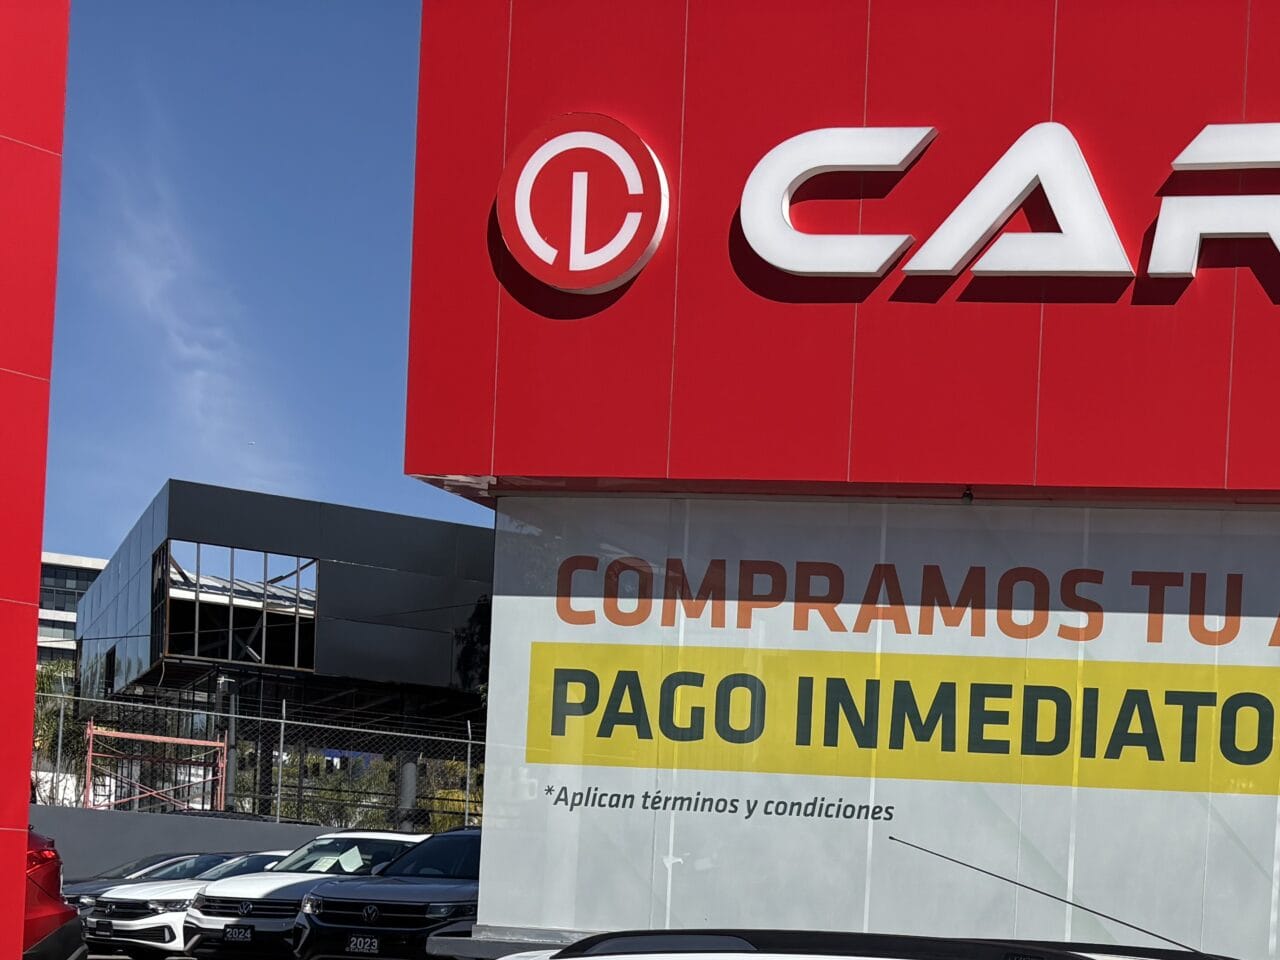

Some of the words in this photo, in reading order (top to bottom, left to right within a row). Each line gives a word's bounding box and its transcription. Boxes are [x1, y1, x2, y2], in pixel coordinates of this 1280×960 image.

[555, 555, 1105, 642] COMPRAMOS
[1131, 571, 1245, 646] TU
[549, 668, 766, 742] PAGO
[641, 790, 739, 814] términos
[745, 800, 758, 819] y
[763, 797, 895, 821] condiciones
[226, 928, 252, 938] 2024
[350, 937, 378, 949] 2023
